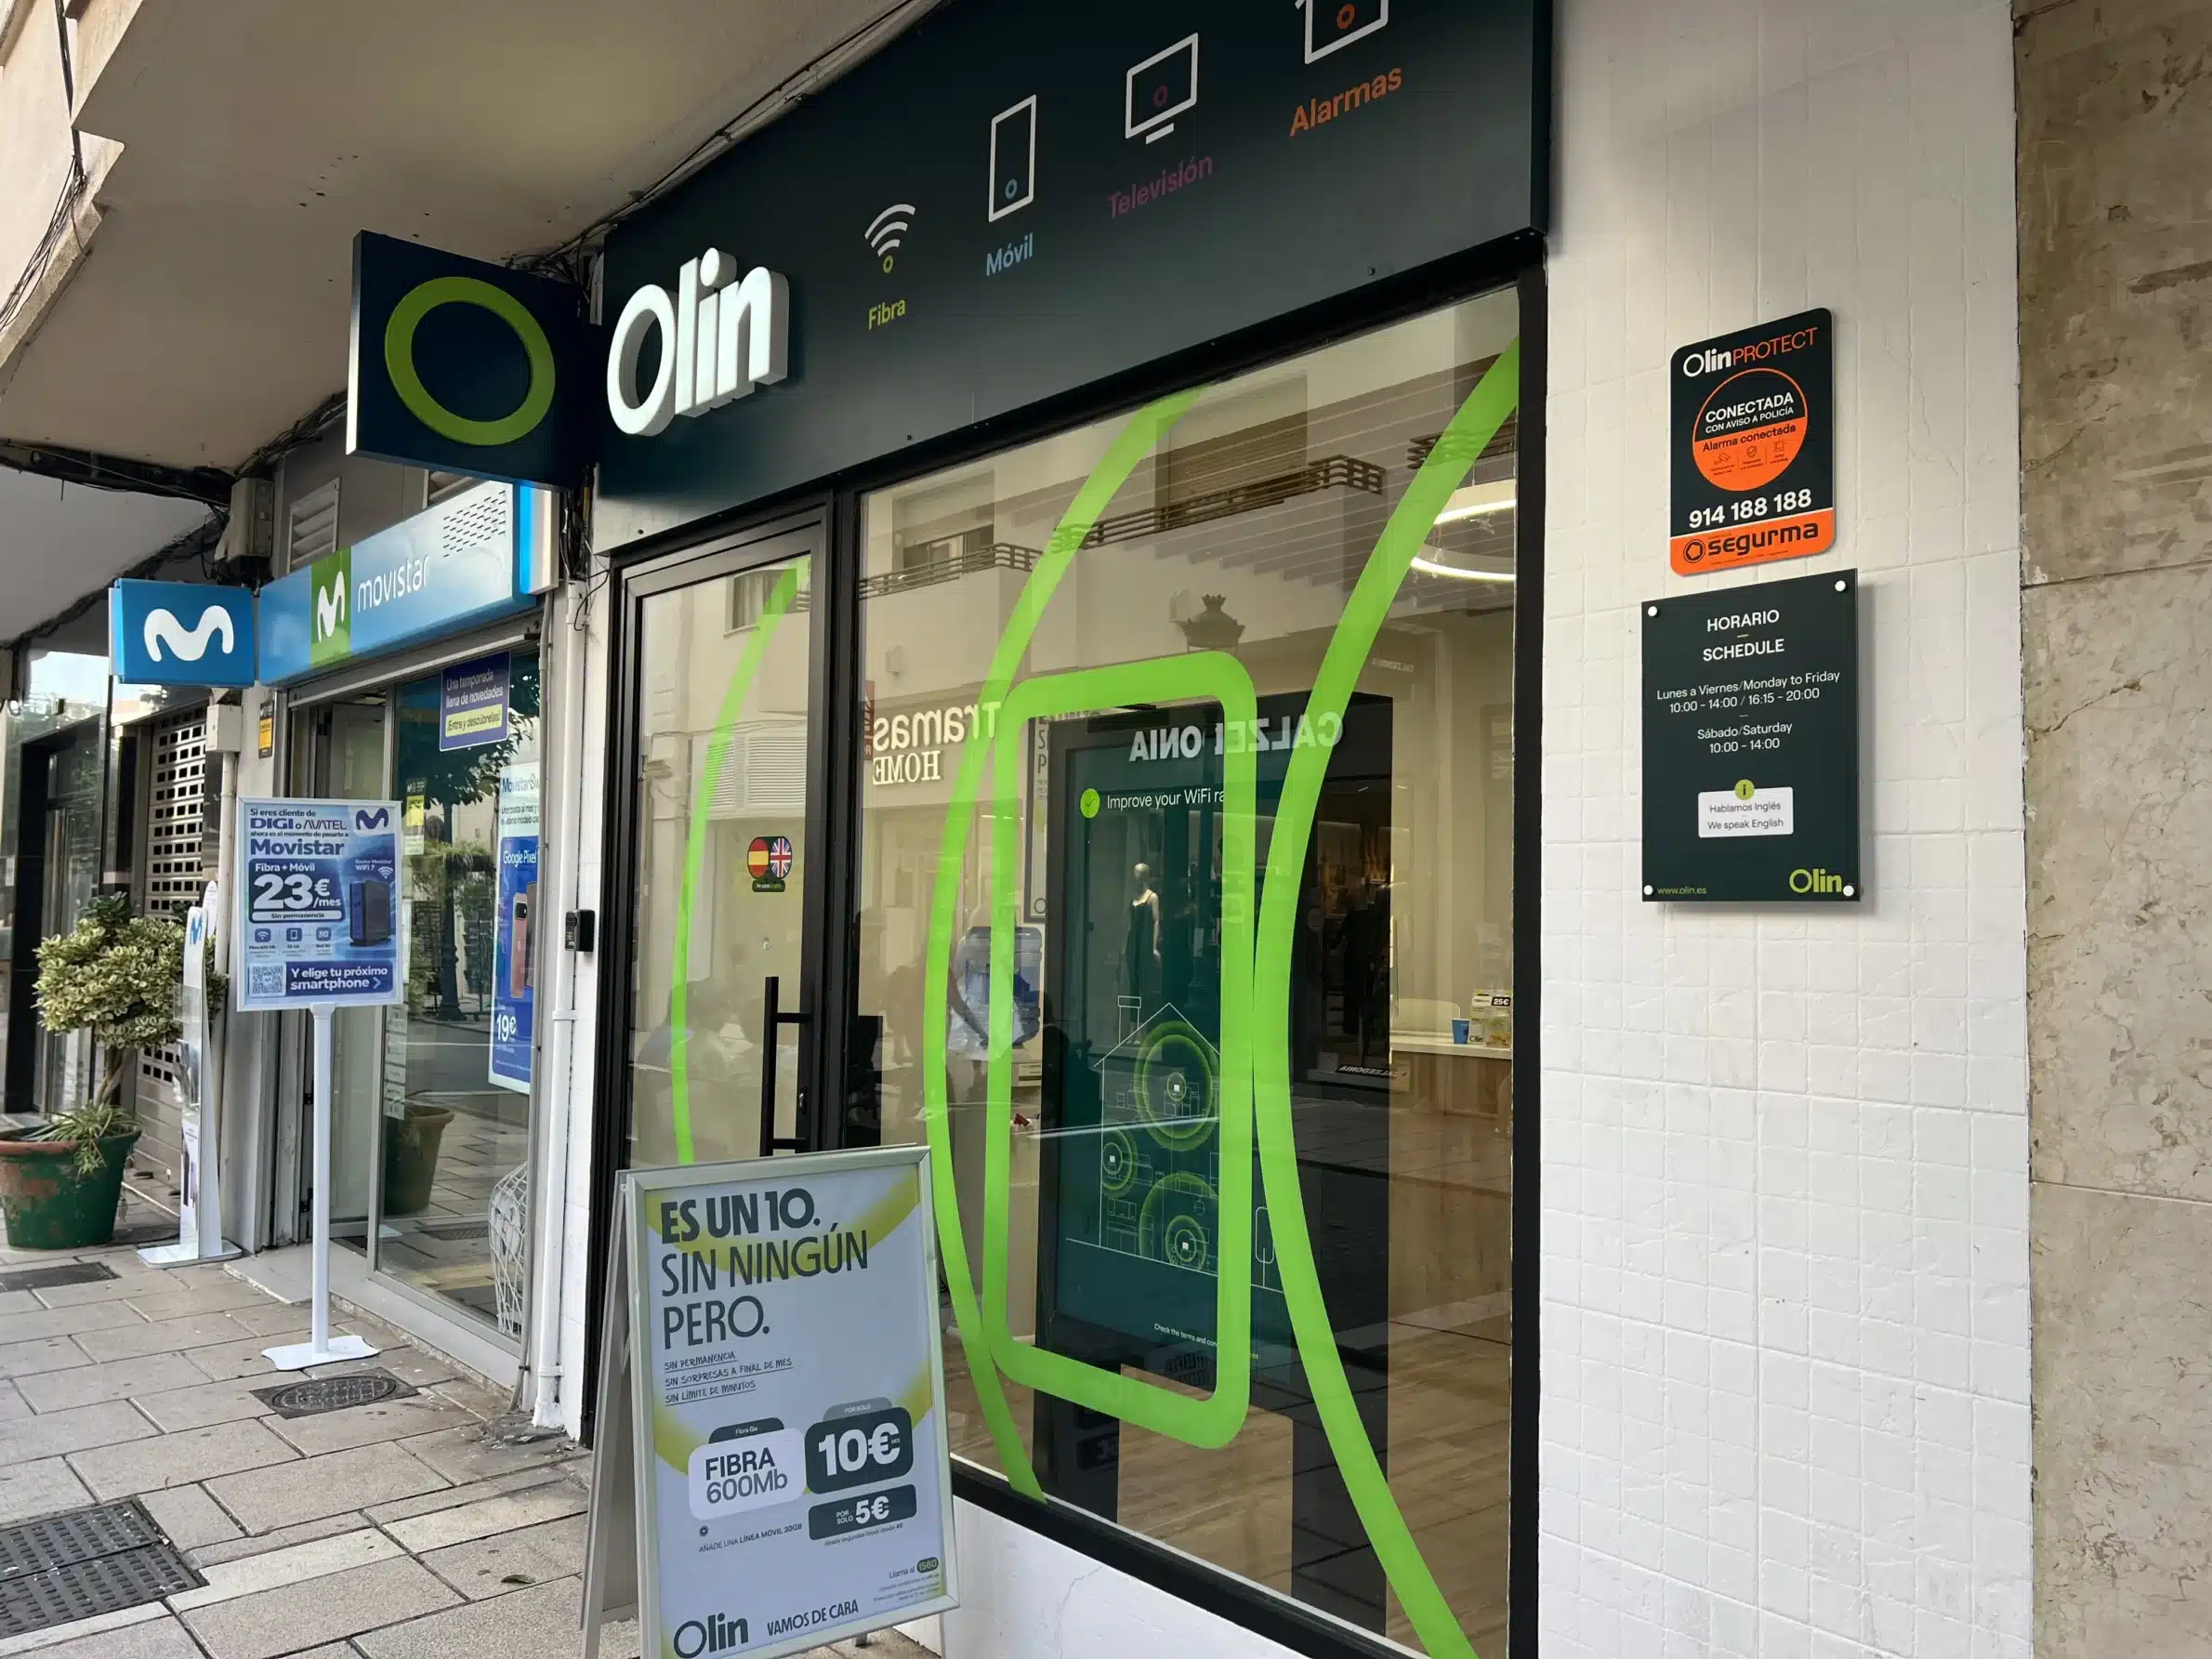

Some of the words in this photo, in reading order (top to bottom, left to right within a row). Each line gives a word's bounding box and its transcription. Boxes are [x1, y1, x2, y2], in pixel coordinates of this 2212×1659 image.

[1289, 67, 1403, 138] Alarmas
[1108, 155, 1213, 219] Televisión
[986, 232, 1034, 277] Móvil
[868, 296, 906, 330] Fibra
[607, 247, 789, 437] Olin
[1705, 391, 1794, 423] CONECTADA
[1705, 422, 1726, 434] CON
[1726, 416, 1750, 430] AVISO
[1752, 415, 1758, 424] A
[1759, 405, 1794, 421] POLICÍA
[1703, 437, 1738, 453] Alarma
[1740, 423, 1797, 444] conectada
[1689, 503, 1726, 529] 914
[1731, 497, 1768, 521] 188
[1773, 488, 1812, 513] 188
[1708, 522, 1819, 556] segurma
[357, 554, 430, 612] movistar
[1706, 609, 1780, 632] HORARIO
[1703, 639, 1784, 662] SCHEDULE
[446, 678, 459, 691] Una
[460, 691, 468, 705] de
[469, 685, 504, 704] novedades
[1656, 688, 1688, 700] Lunes
[1790, 674, 1803, 686] to
[1805, 670, 1840, 685] Friday
[1669, 701, 1698, 714] 10:00
[1708, 695, 1738, 709] 14:00
[1748, 692, 1775, 705] 16:15
[1786, 688, 1820, 702] 20:00
[1709, 742, 1738, 754] 10:00
[1749, 738, 1780, 750] 14:00
[1107, 795, 1152, 811] Improve
[1154, 793, 1181, 810] your
[1184, 787, 1211, 804] WiFi
[1709, 803, 1753, 813] Hablamos
[1755, 801, 1782, 814] Inglés
[250, 818, 294, 829] DIGI
[303, 820, 347, 830] AVATEL
[1707, 821, 1722, 831] We
[1724, 820, 1750, 832] speak
[1752, 818, 1784, 832] English
[250, 838, 345, 856] Movistar
[503, 850, 524, 867] Google
[524, 849, 537, 863] Pixel
[255, 862, 280, 872] Fibra
[289, 862, 316, 872] Móvil
[1789, 868, 1843, 893] Olin
[1656, 885, 1707, 896] www.olin.es
[291, 968, 300, 978] Y
[302, 968, 328, 980] elige
[330, 968, 342, 977] tu
[344, 966, 388, 979] próximo
[291, 977, 370, 991] smartphone
[496, 1013, 517, 1042] 19€
[661, 1199, 697, 1244] ES
[706, 1192, 758, 1238] UN
[764, 1188, 821, 1231] 10.
[662, 1248, 717, 1297] SIN
[730, 1222, 868, 1288] NINGÚN
[664, 1296, 770, 1350] PERO.
[1153, 1323, 1170, 1335] Check
[1171, 1327, 1179, 1336] the
[1180, 1331, 1195, 1341] terms
[1195, 1336, 1206, 1345] and
[665, 1360, 678, 1370] SIN
[680, 1350, 736, 1368] PERMANENCIA
[665, 1376, 678, 1387] SIN
[681, 1368, 729, 1384] SORPRESAS
[731, 1366, 737, 1375] A
[739, 1363, 762, 1374] FINAL
[764, 1360, 773, 1370] DE
[775, 1358, 793, 1369] MES
[665, 1393, 678, 1402] SIN
[709, 1386, 719, 1395] DE
[721, 1380, 757, 1393] MINUTOS
[818, 1422, 901, 1476] 10€
[705, 1447, 775, 1481] FIBRA
[706, 1468, 788, 1504] 600Mb
[836, 1516, 853, 1525] SOLO
[856, 1495, 889, 1524] 5€
[699, 1541, 723, 1553] AÑADE
[724, 1539, 739, 1547] UNA
[740, 1533, 760, 1544] LÍNEA
[761, 1527, 783, 1538] MÓVIL
[783, 1523, 803, 1534] 30GB
[889, 1569, 909, 1579] Llama
[673, 1613, 749, 1659] Olin
[767, 1614, 809, 1637] VAMOS
[811, 1603, 827, 1624] DE
[829, 1599, 859, 1619] CARA
